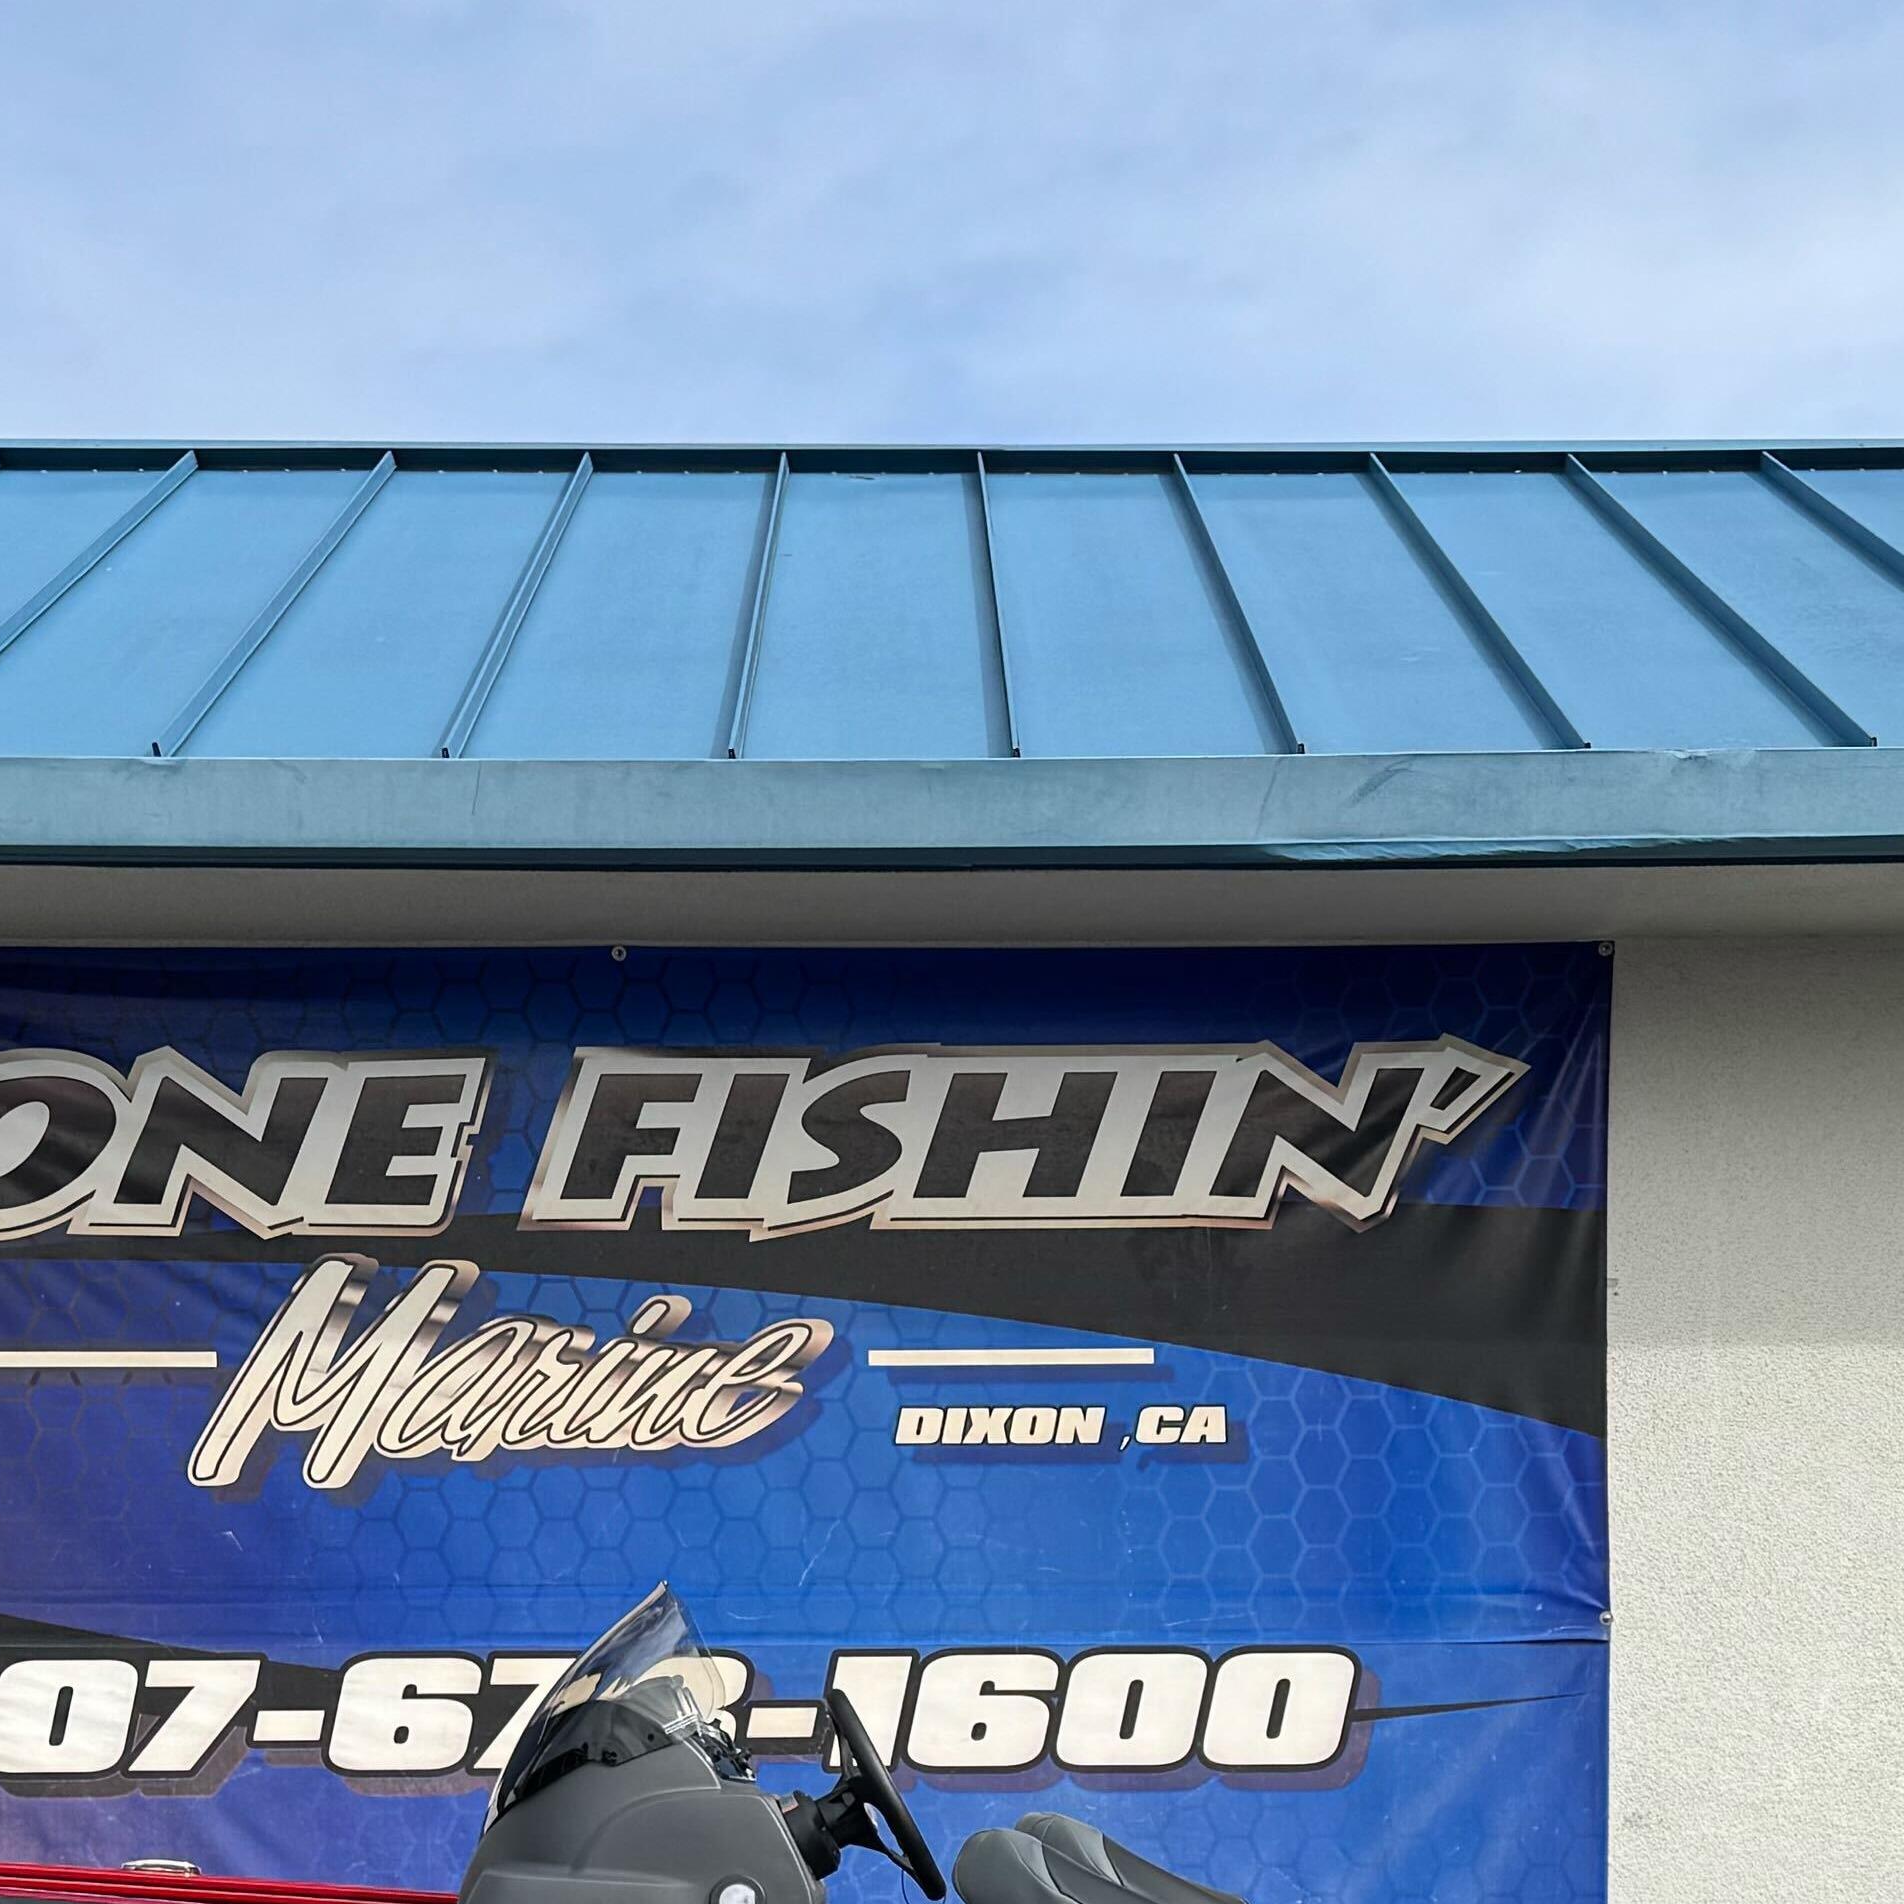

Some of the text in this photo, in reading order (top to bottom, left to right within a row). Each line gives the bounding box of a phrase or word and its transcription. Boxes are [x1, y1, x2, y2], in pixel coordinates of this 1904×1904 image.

[519, 1036, 1530, 1239] FISHIN'
[188, 1252, 834, 1487] Marine
[895, 1406, 1106, 1444] DIXON
